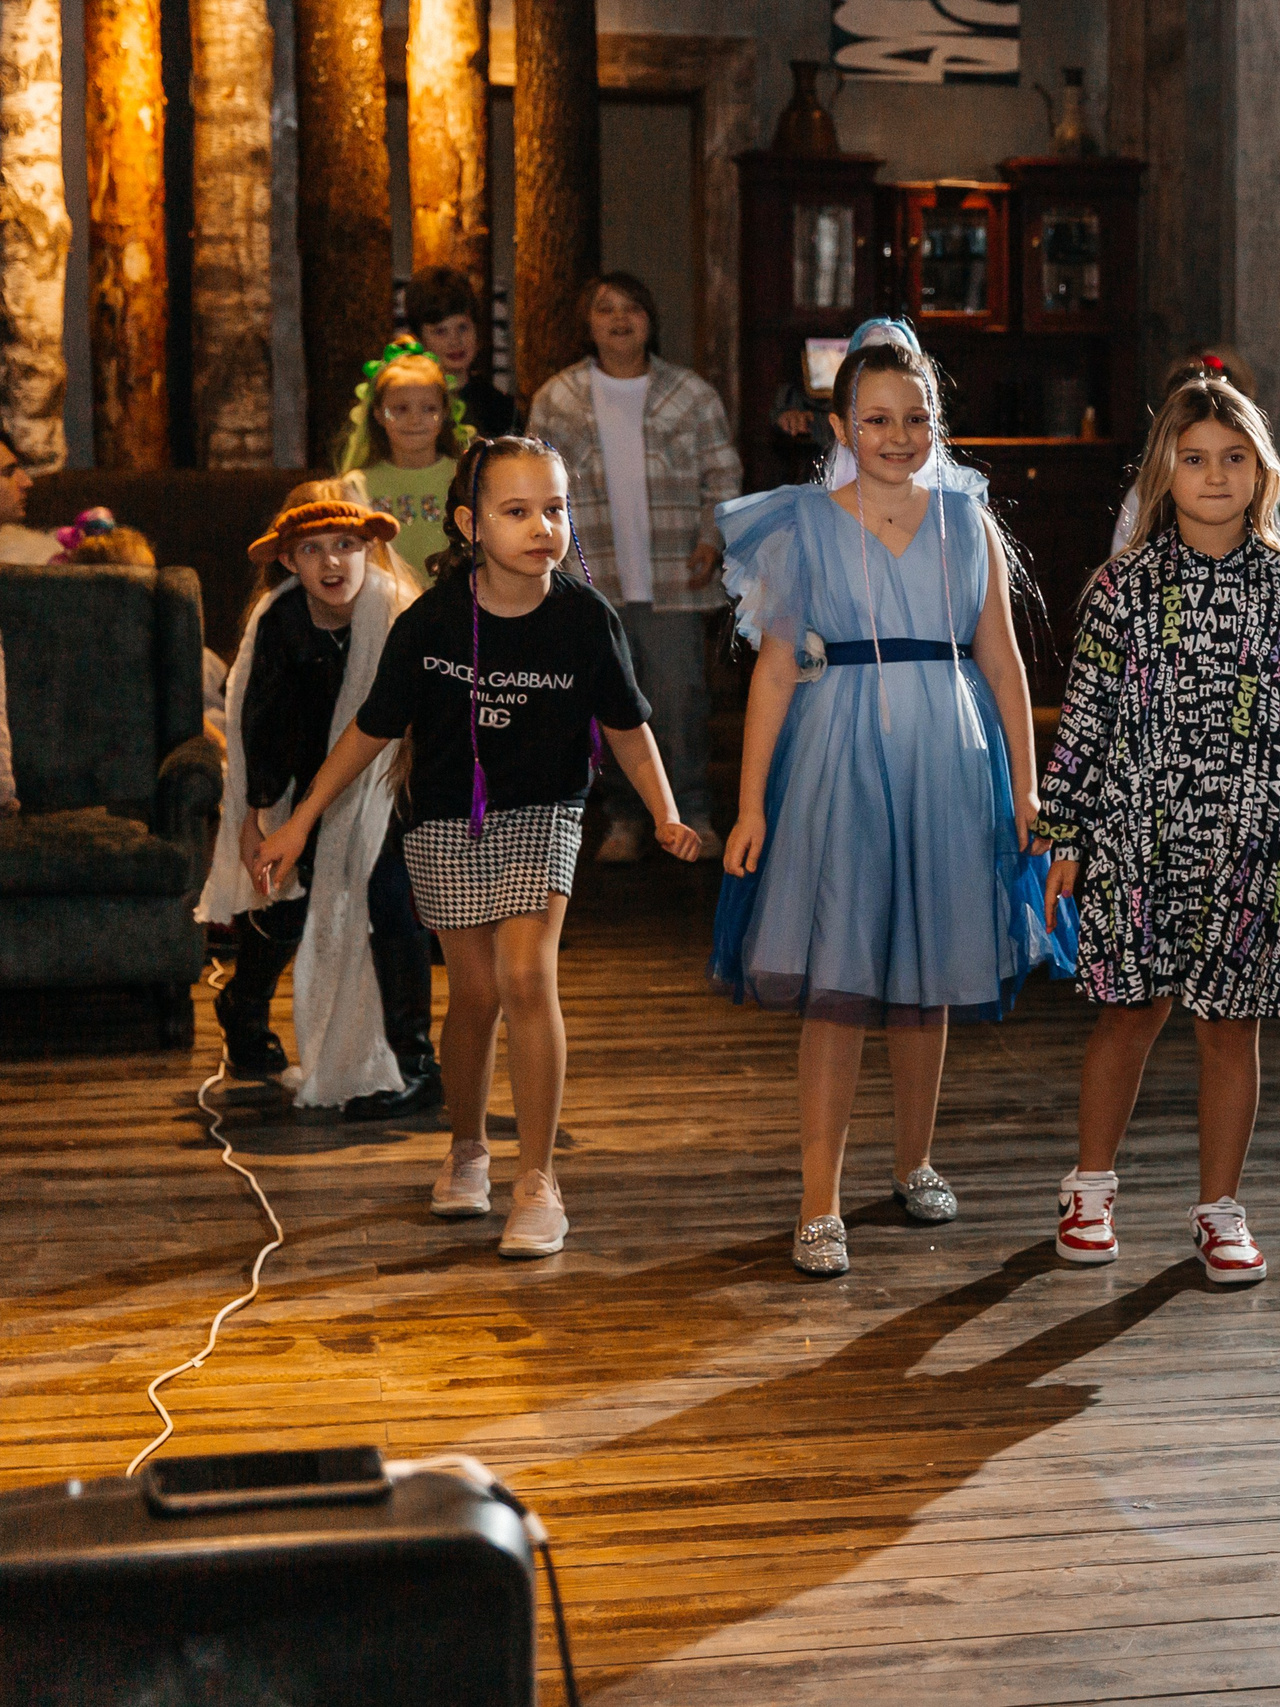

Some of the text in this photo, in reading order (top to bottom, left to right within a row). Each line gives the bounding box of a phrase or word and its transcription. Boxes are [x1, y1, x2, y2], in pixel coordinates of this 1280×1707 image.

[1162, 584, 1182, 650] MSGM
[1244, 584, 1259, 638] SPACE
[423, 656, 475, 684] DOLCE
[477, 676, 486, 686] &
[470, 690, 528, 705] MILANO
[478, 706, 511, 729] DG
[1231, 674, 1259, 739] MSGM
